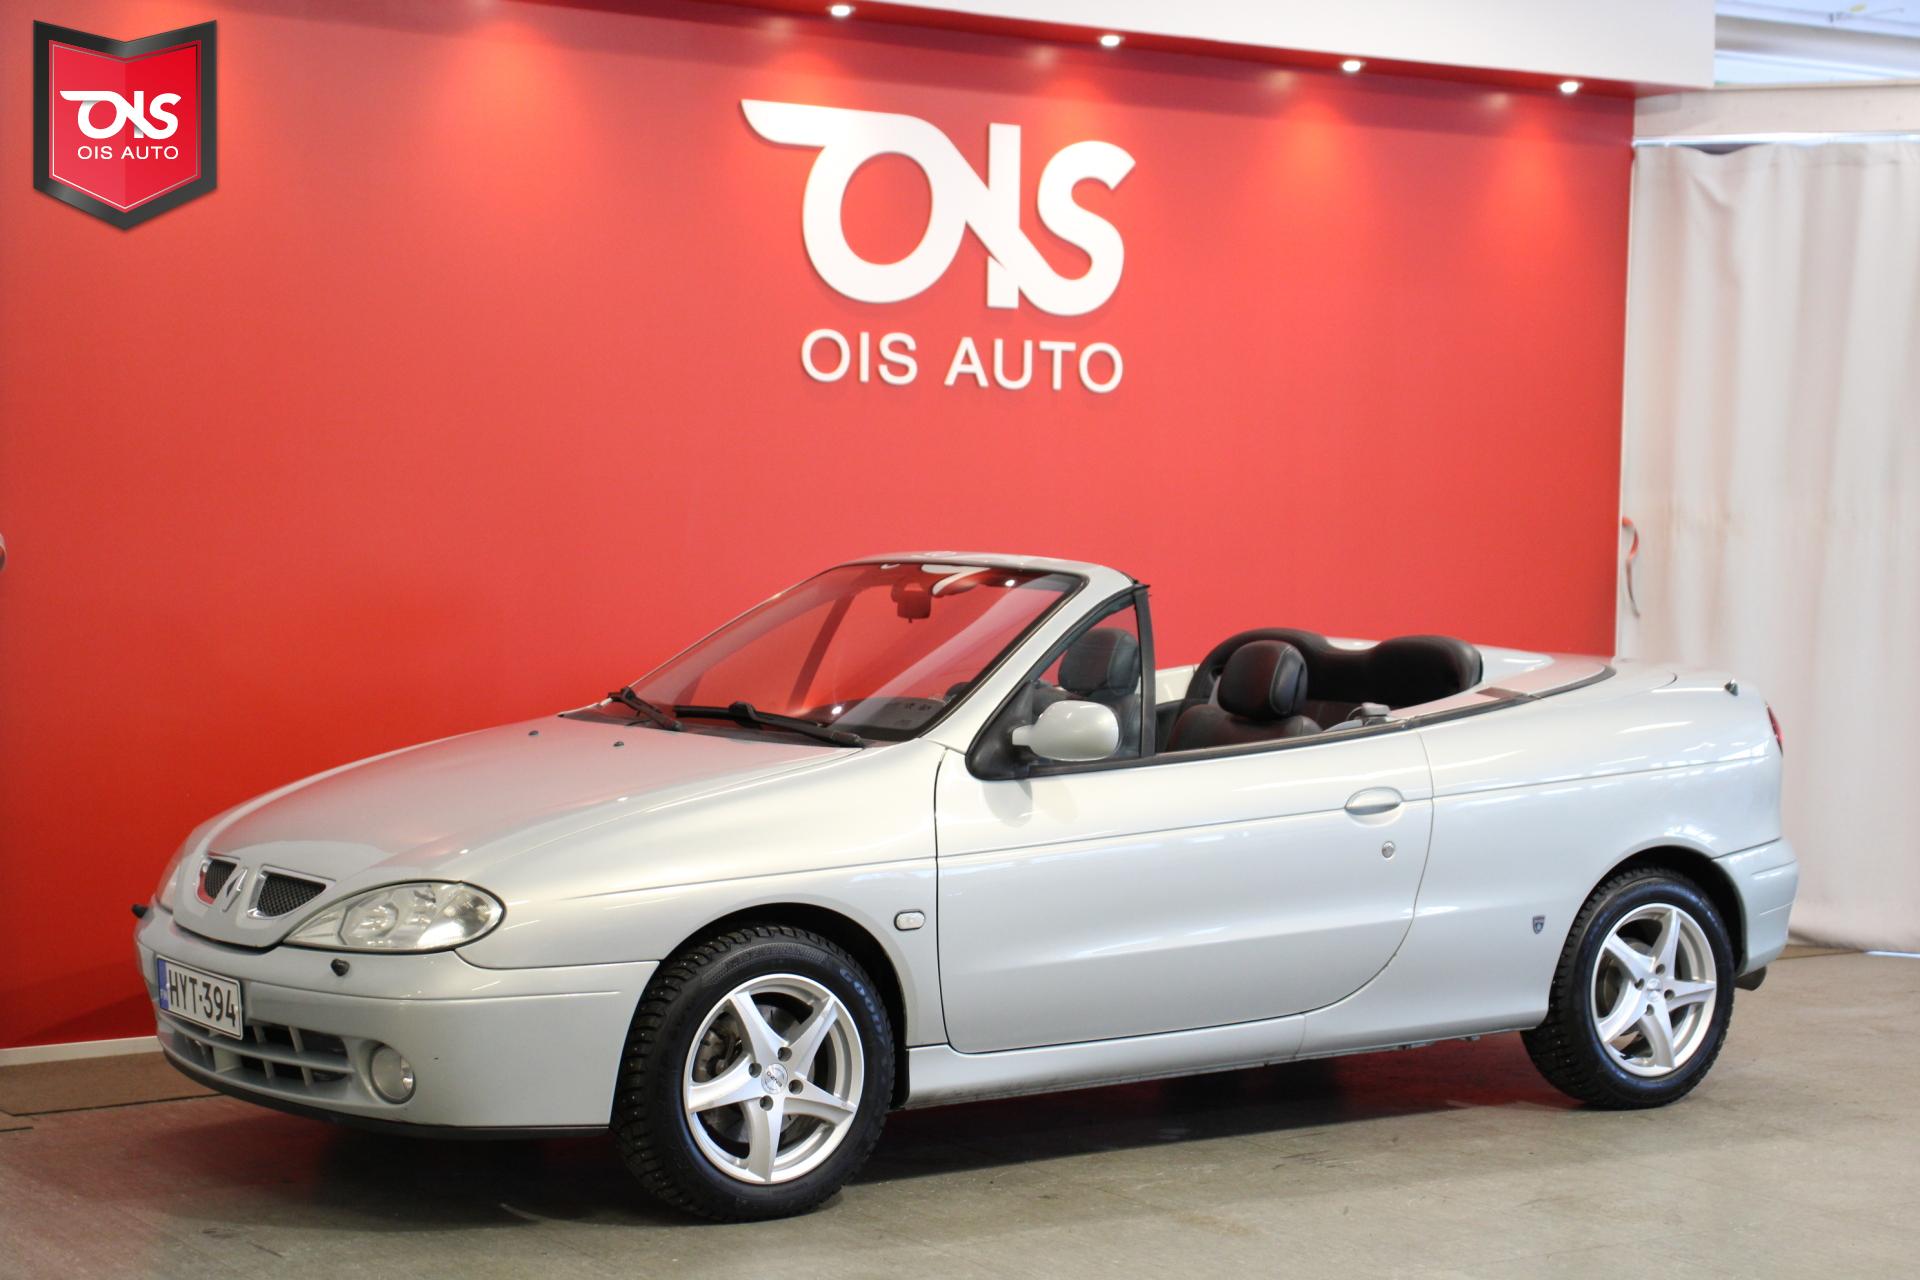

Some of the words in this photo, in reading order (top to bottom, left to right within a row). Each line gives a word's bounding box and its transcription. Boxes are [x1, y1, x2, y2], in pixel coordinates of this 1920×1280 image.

[741, 98, 1136, 316] OIS
[801, 328, 919, 385] OIS
[943, 336, 1124, 393] AUTO
[168, 969, 236, 1027] HYT-394
